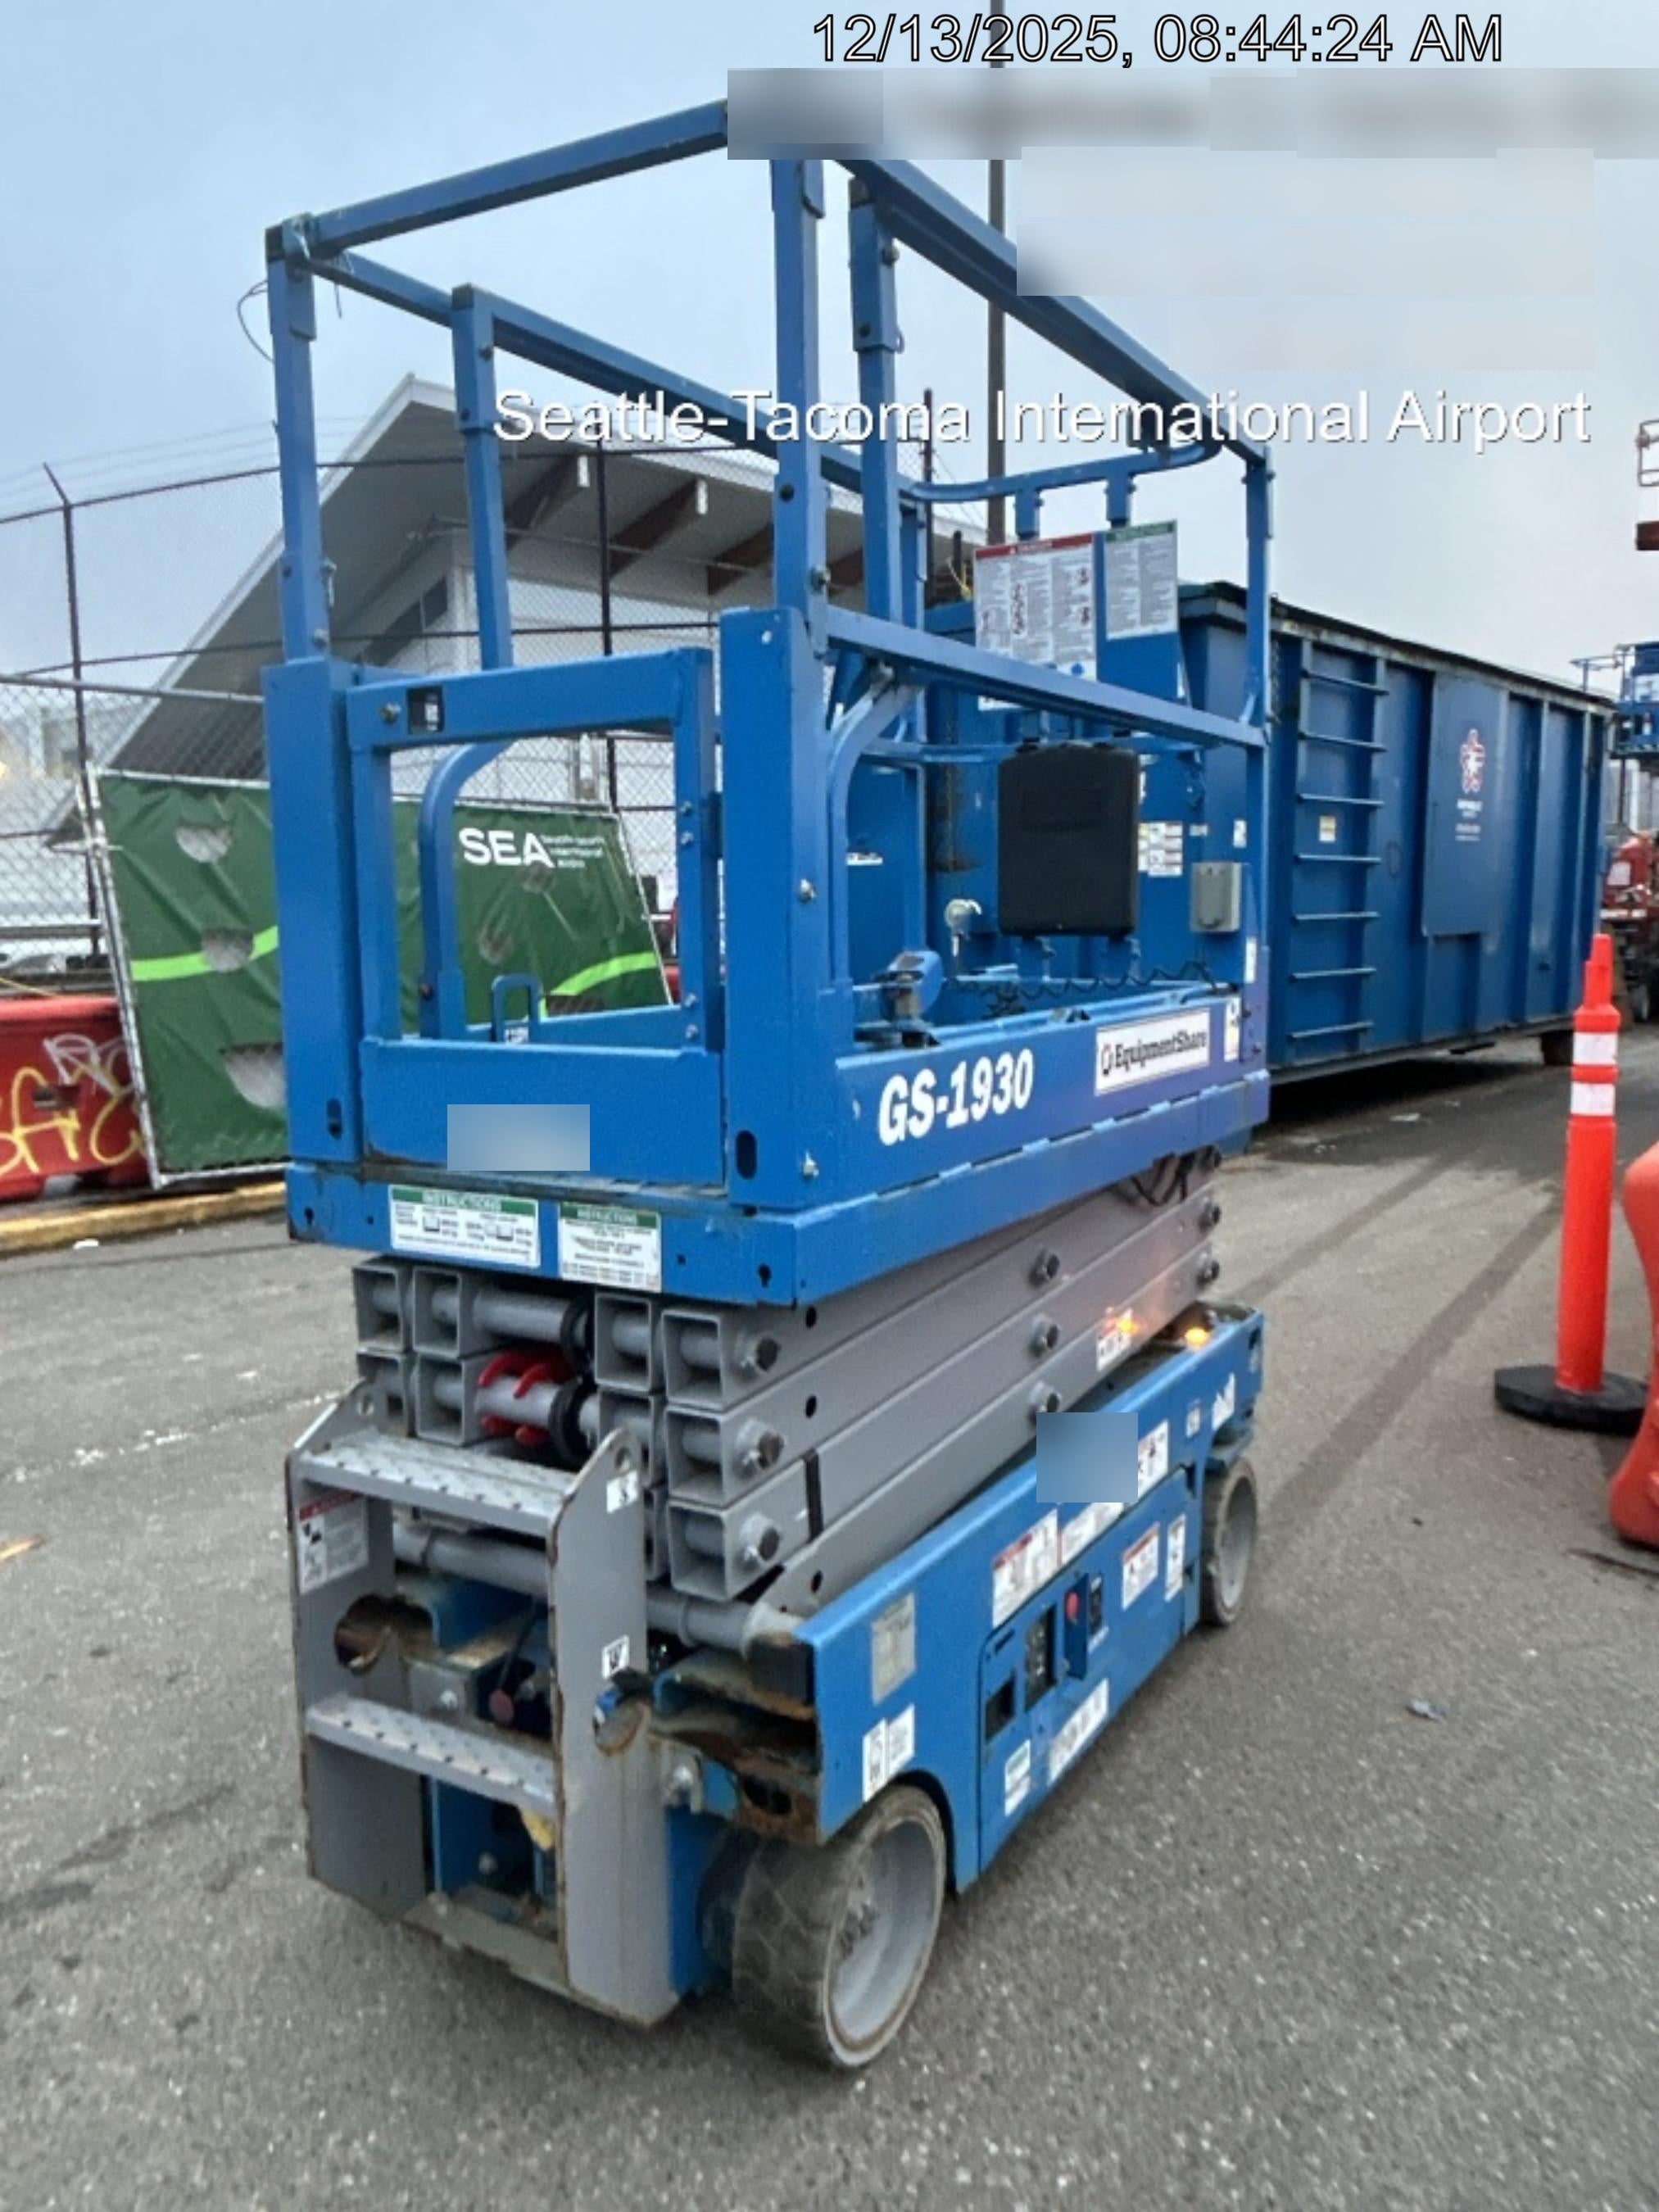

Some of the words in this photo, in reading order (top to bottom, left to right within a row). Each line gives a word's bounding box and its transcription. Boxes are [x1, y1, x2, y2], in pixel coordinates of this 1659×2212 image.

[459, 827, 555, 868] SEA
[1115, 1030, 1208, 1072] EquipmentShare
[878, 1048, 1034, 1146] GS-1930
